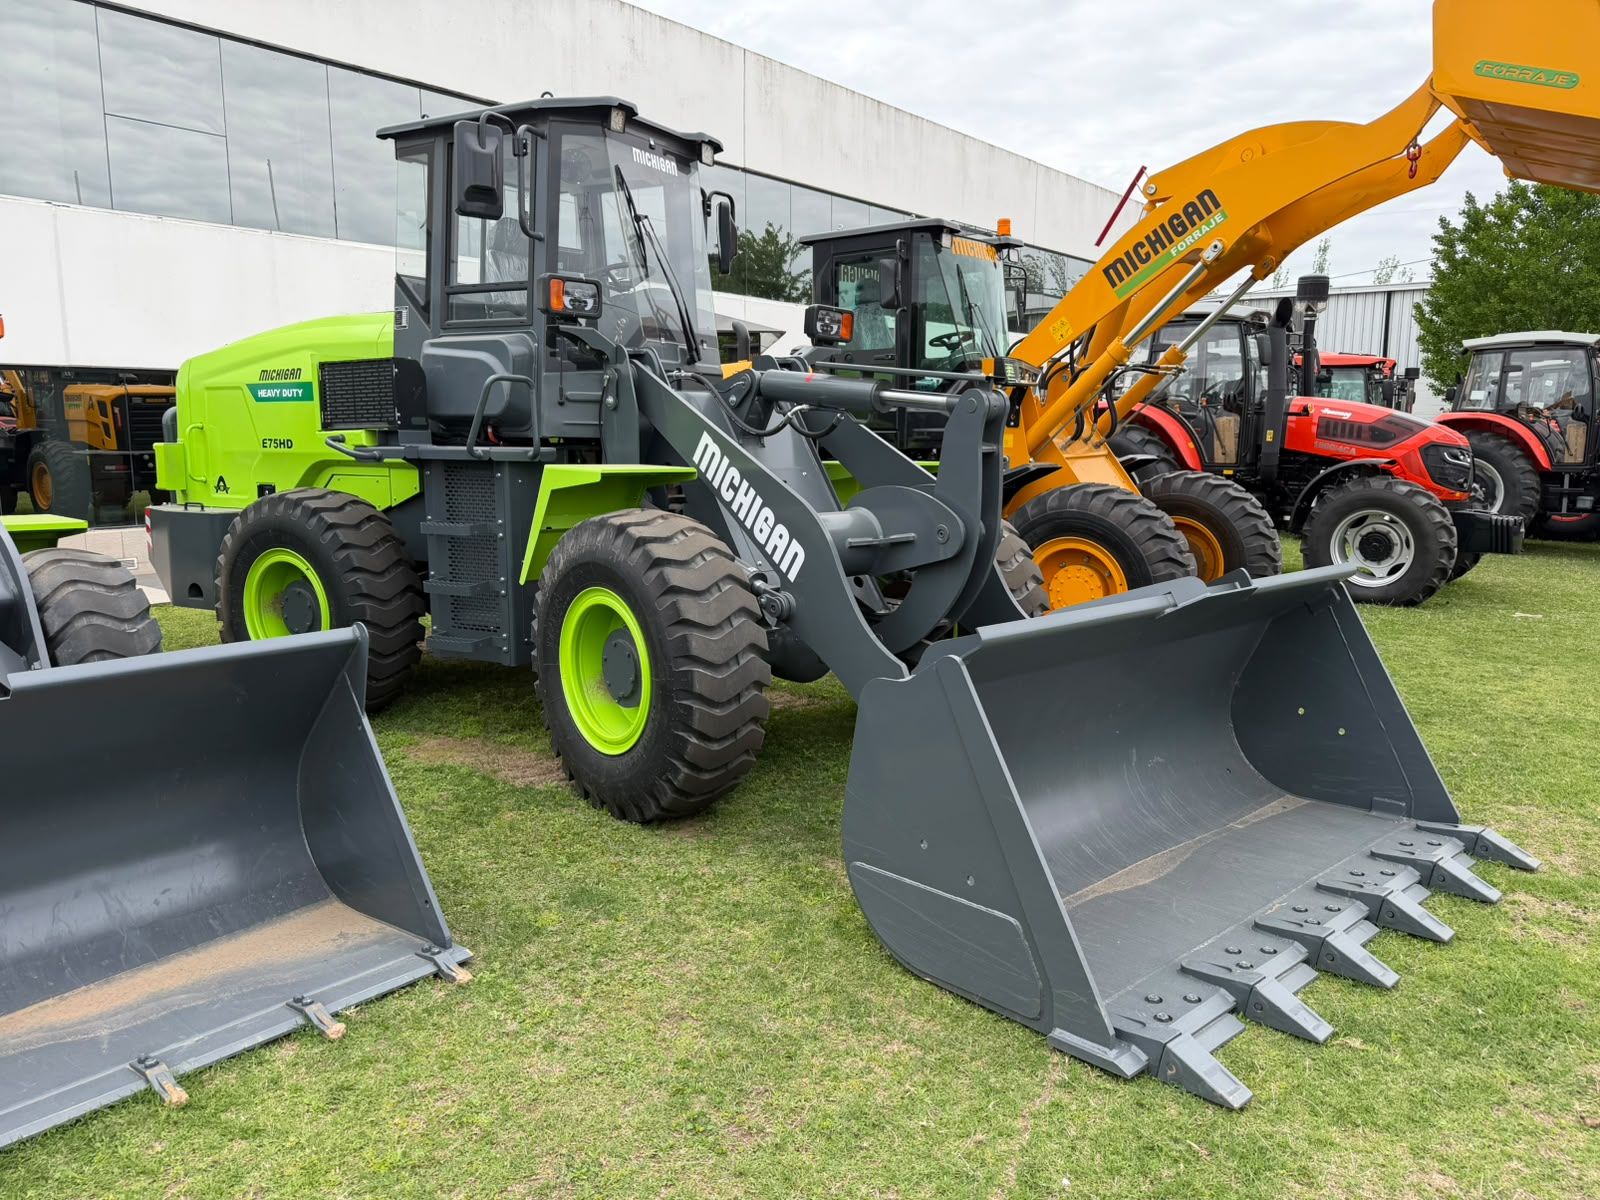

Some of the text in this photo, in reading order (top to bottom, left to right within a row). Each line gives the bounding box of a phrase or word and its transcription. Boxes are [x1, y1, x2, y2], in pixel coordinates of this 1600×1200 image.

[1481, 64, 1570, 85] FORRAJE
[632, 146, 678, 177] MICHIGAN
[1102, 188, 1222, 289] MICHIGAN
[1170, 211, 1225, 257] FORRAJE
[258, 368, 302, 381] MICHIGAN
[257, 388, 303, 398] HEAVY DUTY
[262, 438, 293, 449] E75HD
[692, 430, 806, 583] MICHIGAN
